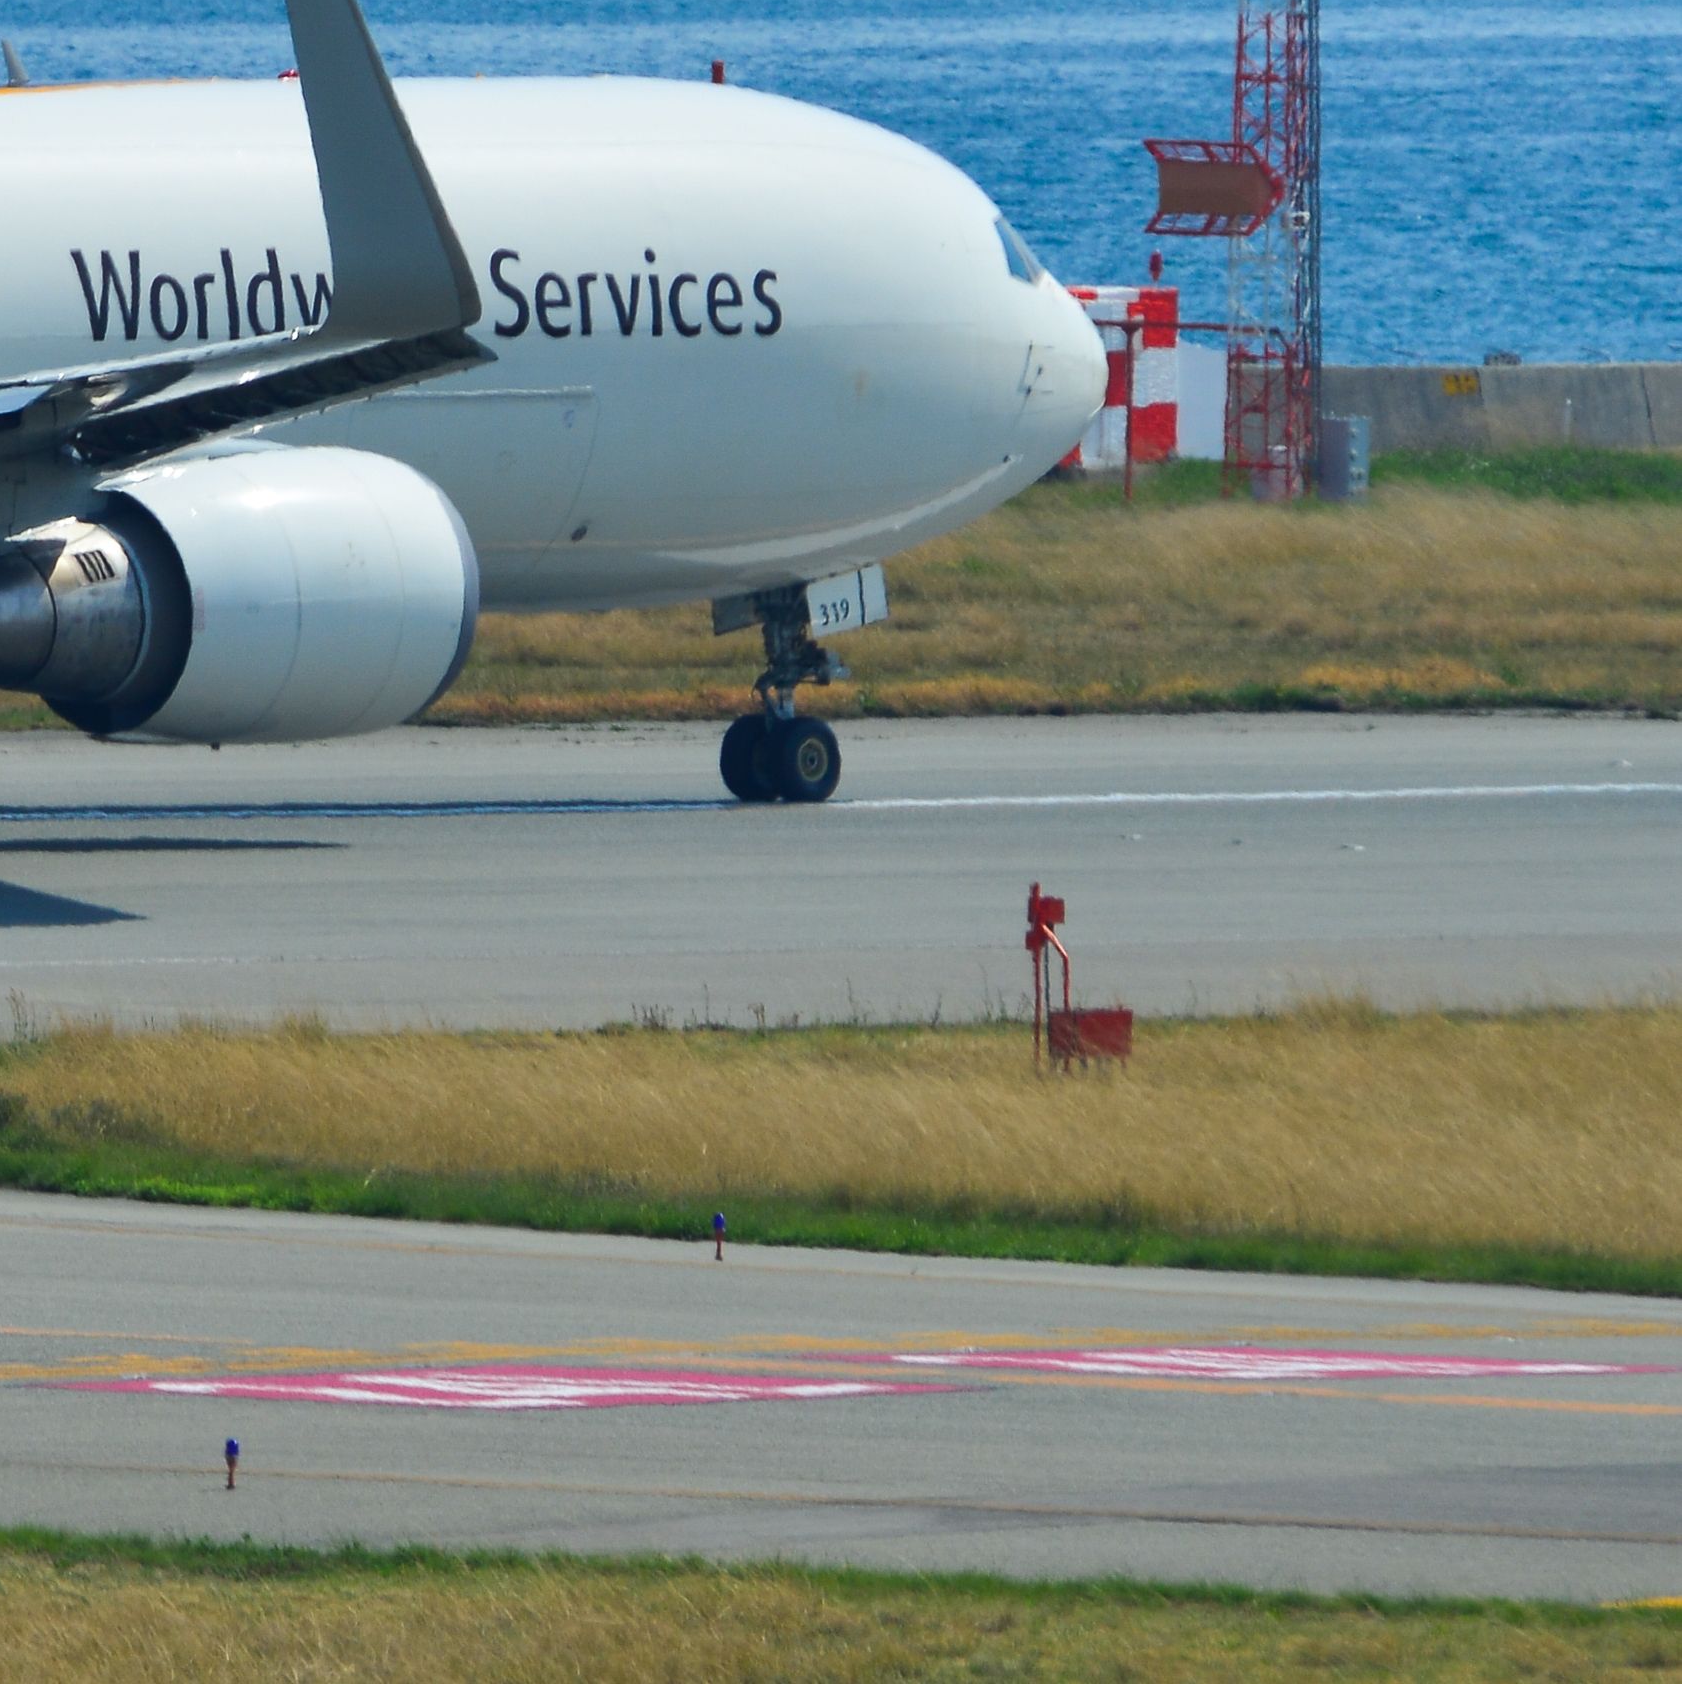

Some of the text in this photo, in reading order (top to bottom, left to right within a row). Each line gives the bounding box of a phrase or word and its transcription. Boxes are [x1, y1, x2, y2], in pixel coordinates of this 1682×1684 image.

[70, 247, 782, 341] Worldw Services
[819, 597, 850, 626] 319
